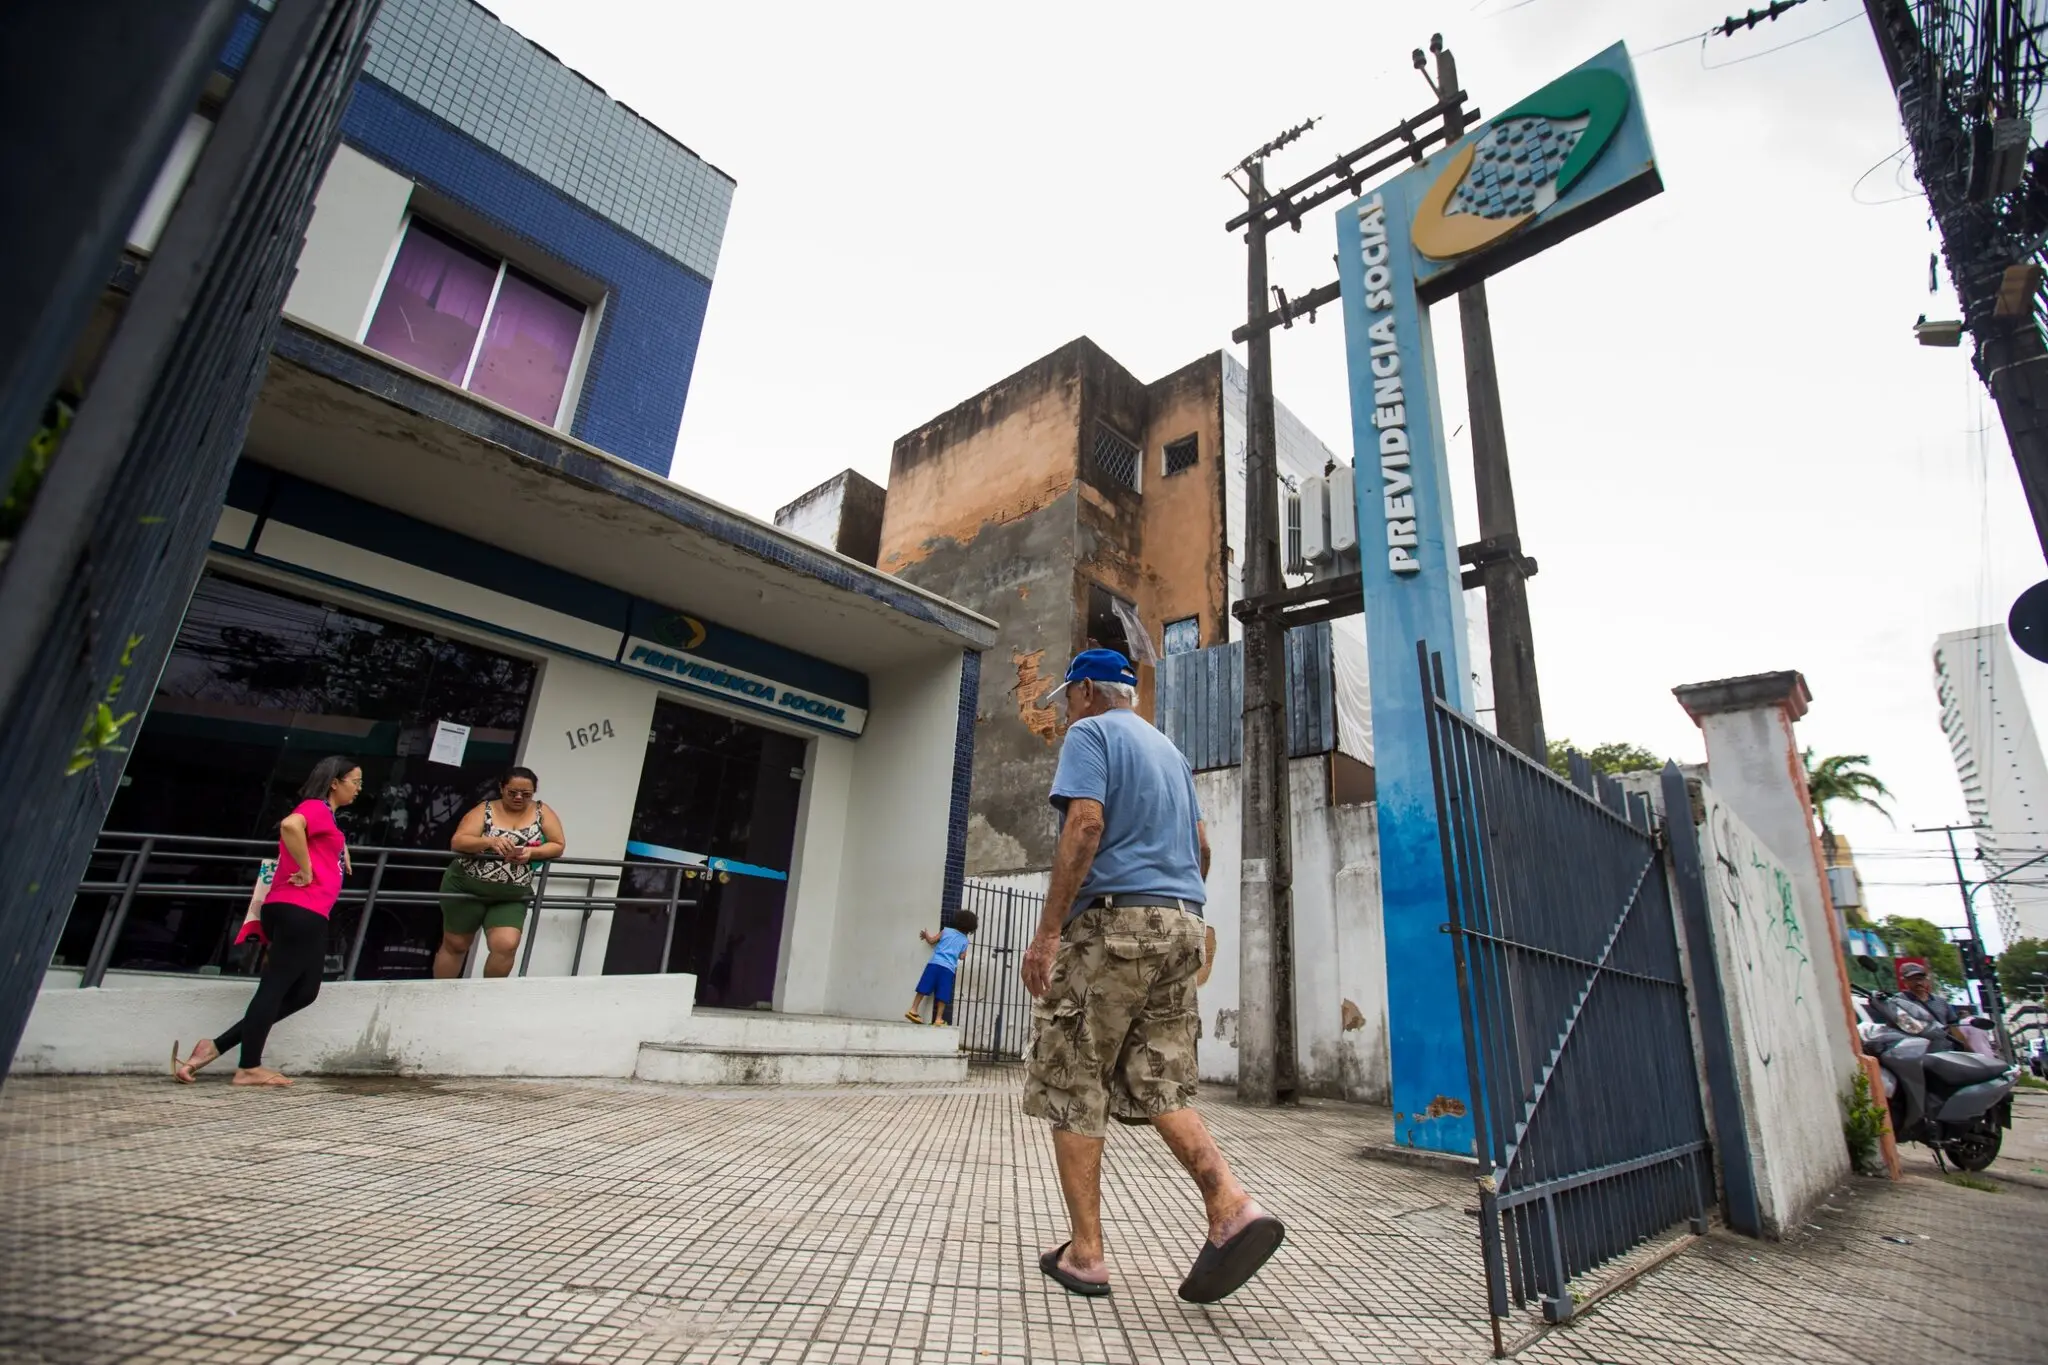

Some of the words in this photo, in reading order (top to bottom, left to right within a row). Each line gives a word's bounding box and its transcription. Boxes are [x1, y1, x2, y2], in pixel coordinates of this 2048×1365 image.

[1357, 191, 1394, 313] SOCIAL
[1368, 314, 1421, 573] PREVIDÊNCIA
[565, 718, 615, 750] 1624
[778, 691, 846, 724] SOCIAL
